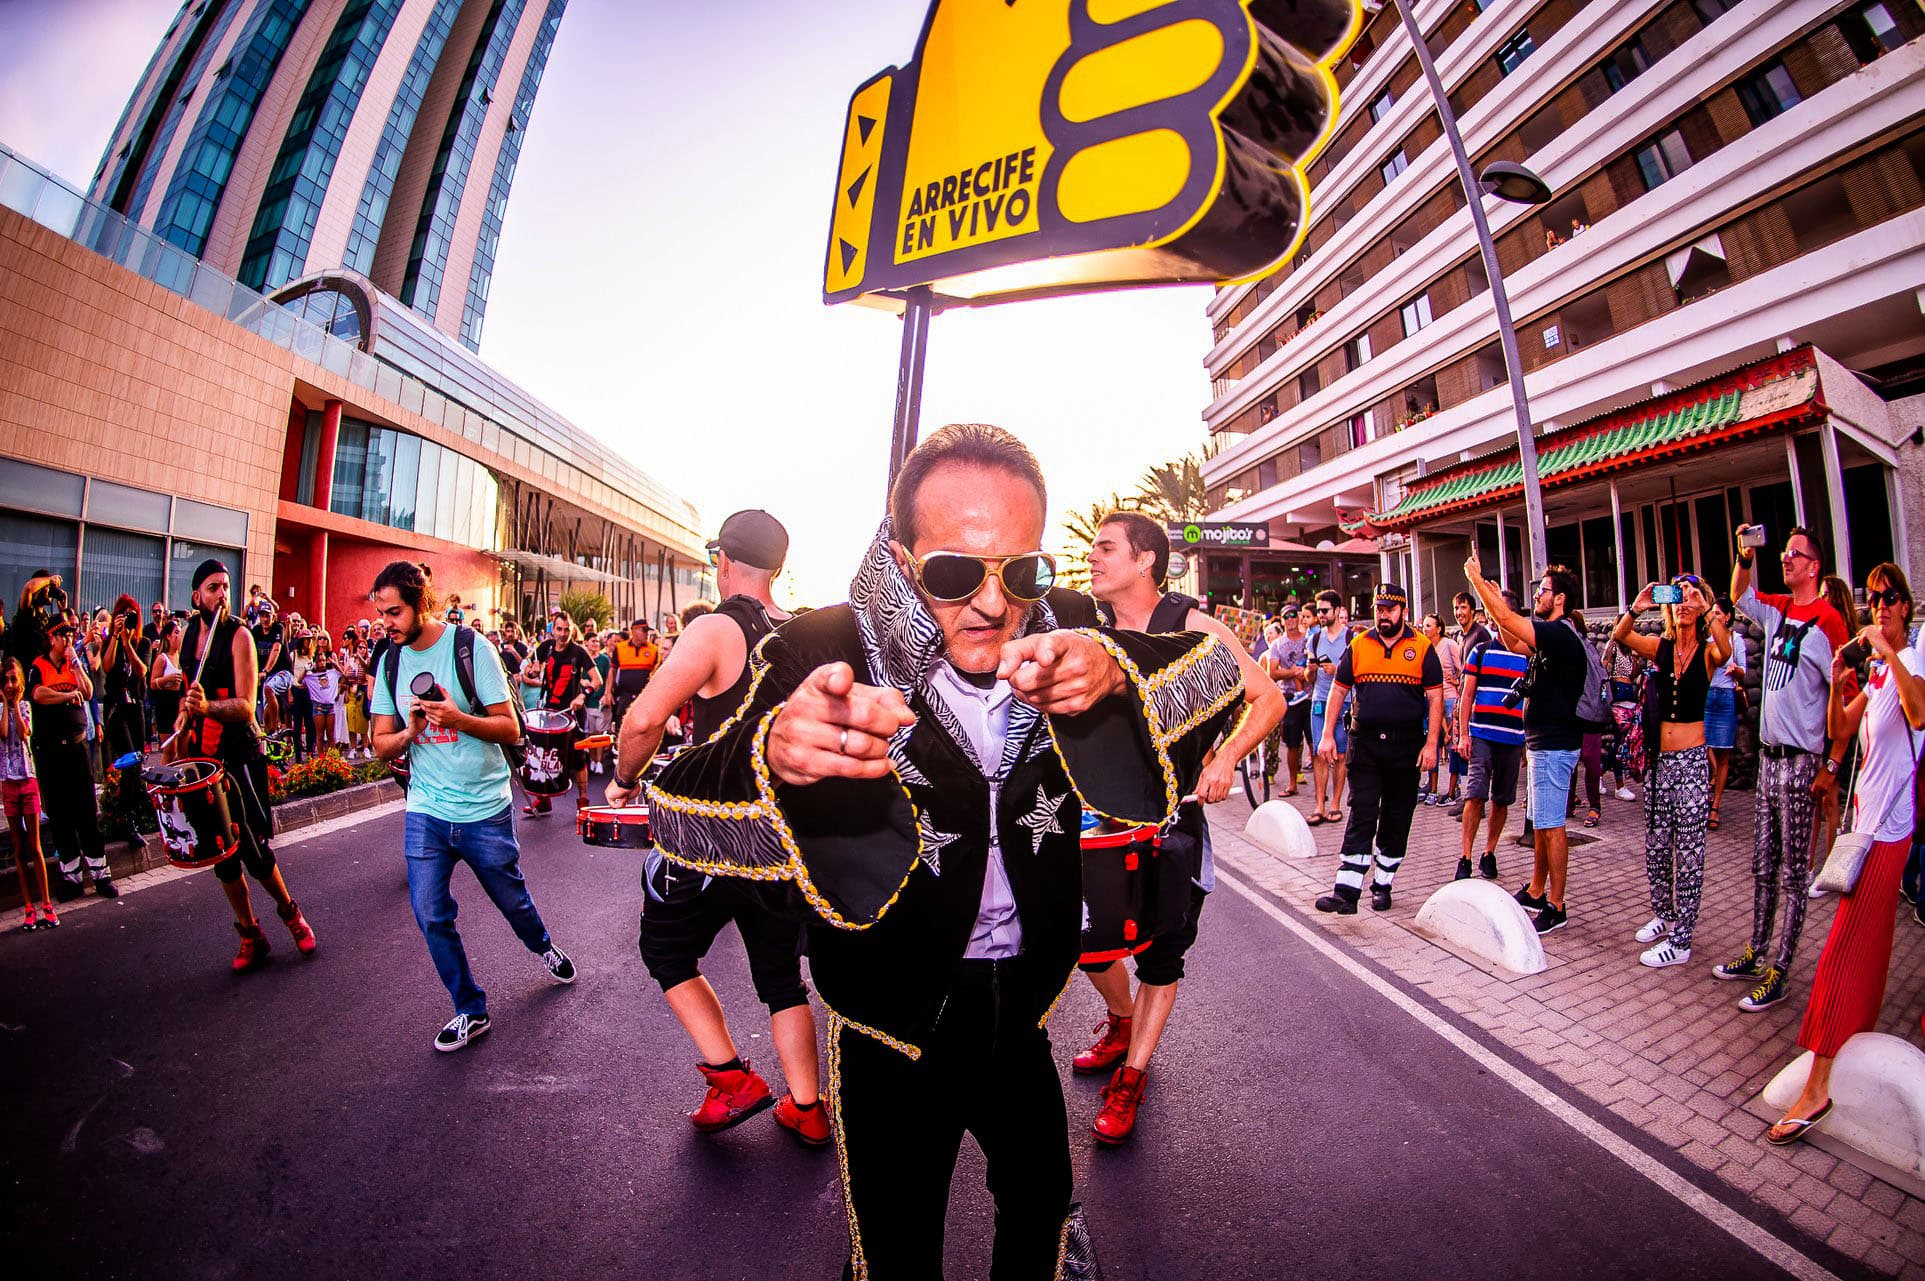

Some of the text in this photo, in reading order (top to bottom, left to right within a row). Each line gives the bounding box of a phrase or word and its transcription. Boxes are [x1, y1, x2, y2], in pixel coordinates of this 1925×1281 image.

[907, 146, 1036, 220] ARRECIFE
[902, 188, 1030, 255] EN VIVO
[1200, 526, 1253, 544] mojito's
